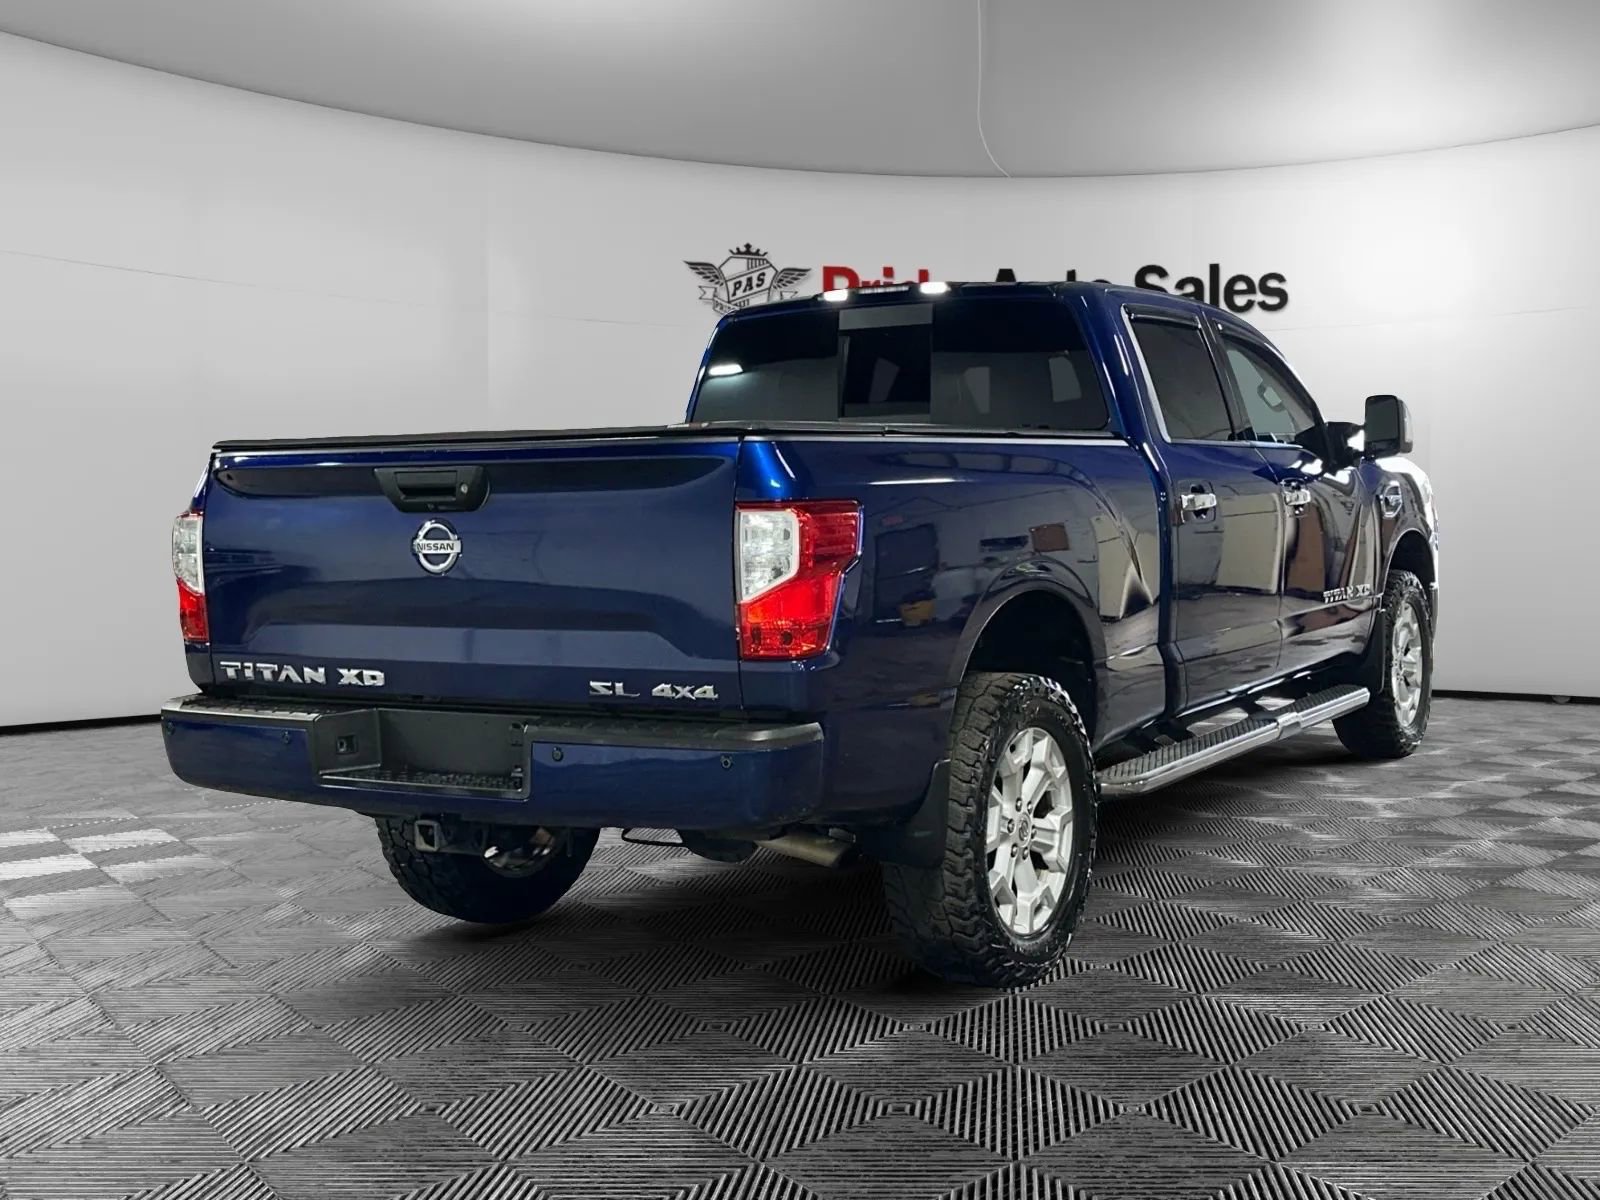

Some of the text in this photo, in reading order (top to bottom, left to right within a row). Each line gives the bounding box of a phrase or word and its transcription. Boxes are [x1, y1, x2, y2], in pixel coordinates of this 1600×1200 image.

[731, 272, 766, 297] PAS
[1134, 263, 1289, 313] Sales
[416, 542, 455, 551] NISSAN
[219, 661, 386, 687] TITAN XD
[589, 680, 641, 697] SL
